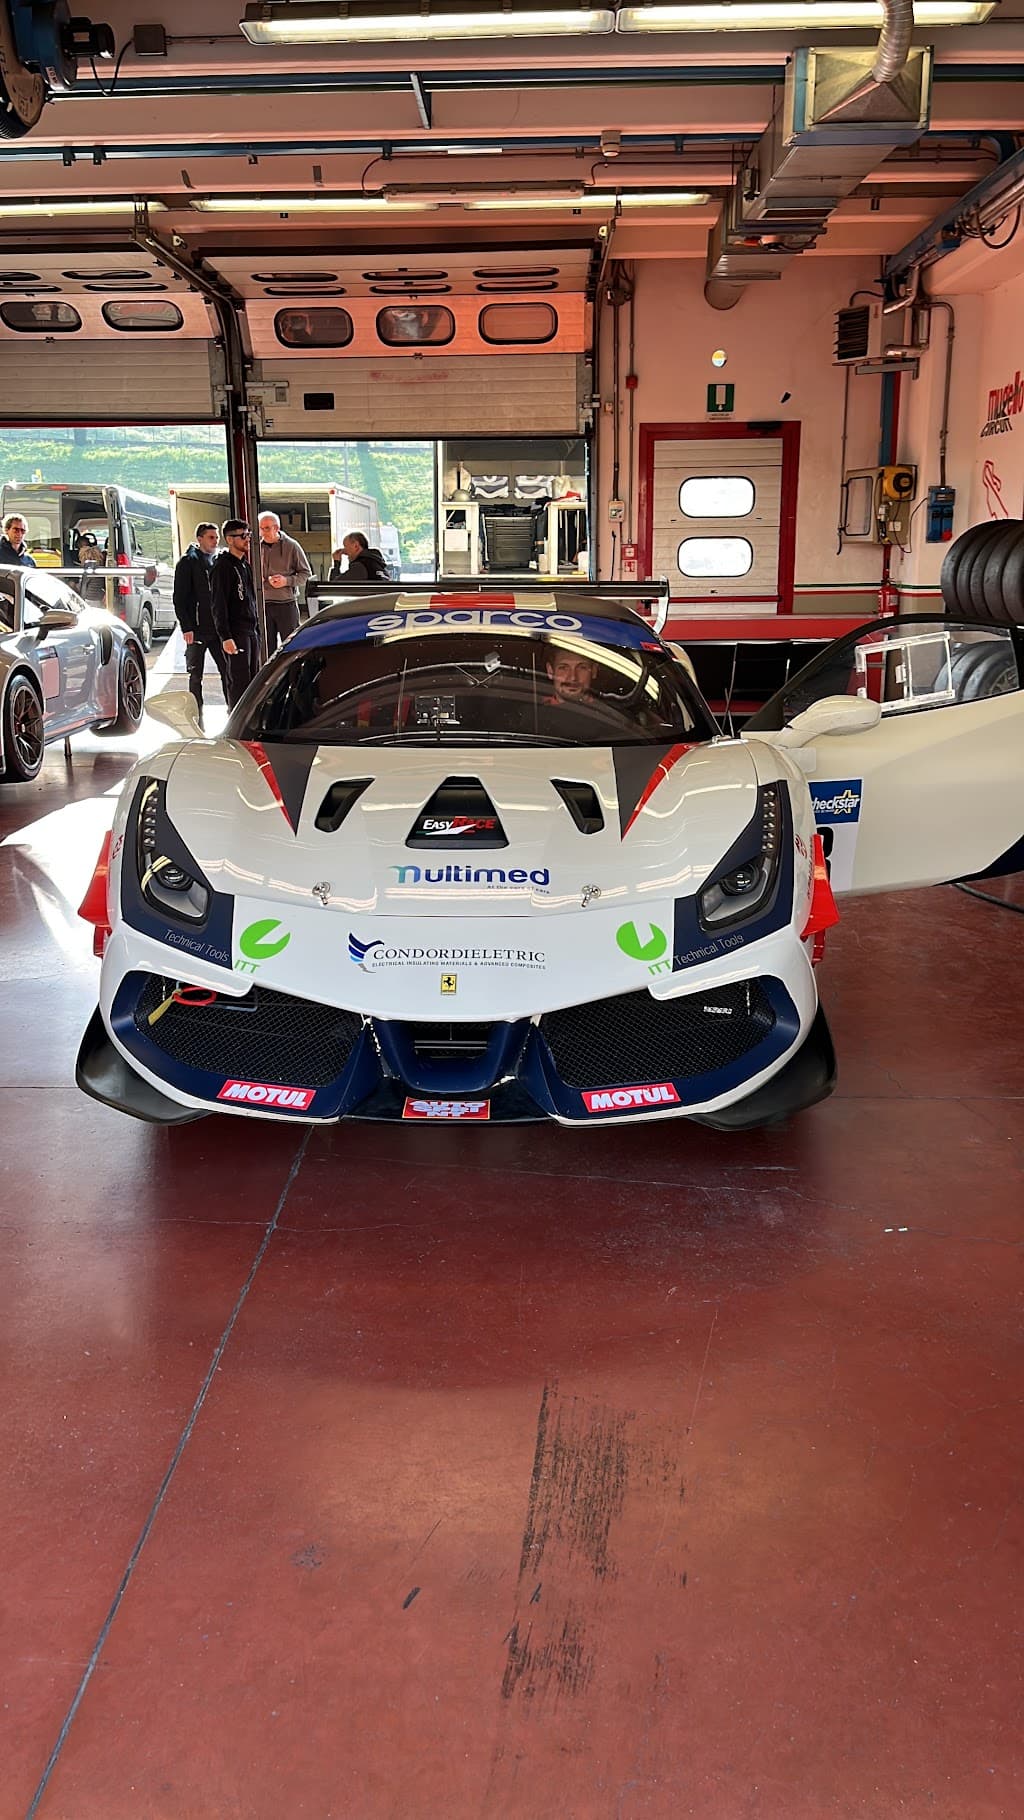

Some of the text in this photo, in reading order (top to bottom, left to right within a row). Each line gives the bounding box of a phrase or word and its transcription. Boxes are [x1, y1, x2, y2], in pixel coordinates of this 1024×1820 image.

[980, 418, 1013, 438] CIRCUIT
[367, 610, 583, 632] sparco
[812, 796, 861, 811] heckstar
[164, 928, 261, 975] Technical Tools ITT
[373, 948, 546, 963] CONDORDIELETRIC
[648, 934, 745, 976] ITT Technical Tools
[510, 962, 546, 970] COMPOSITES
[223, 1083, 308, 1107] MOTUL
[591, 1086, 675, 1110] MOTUL
